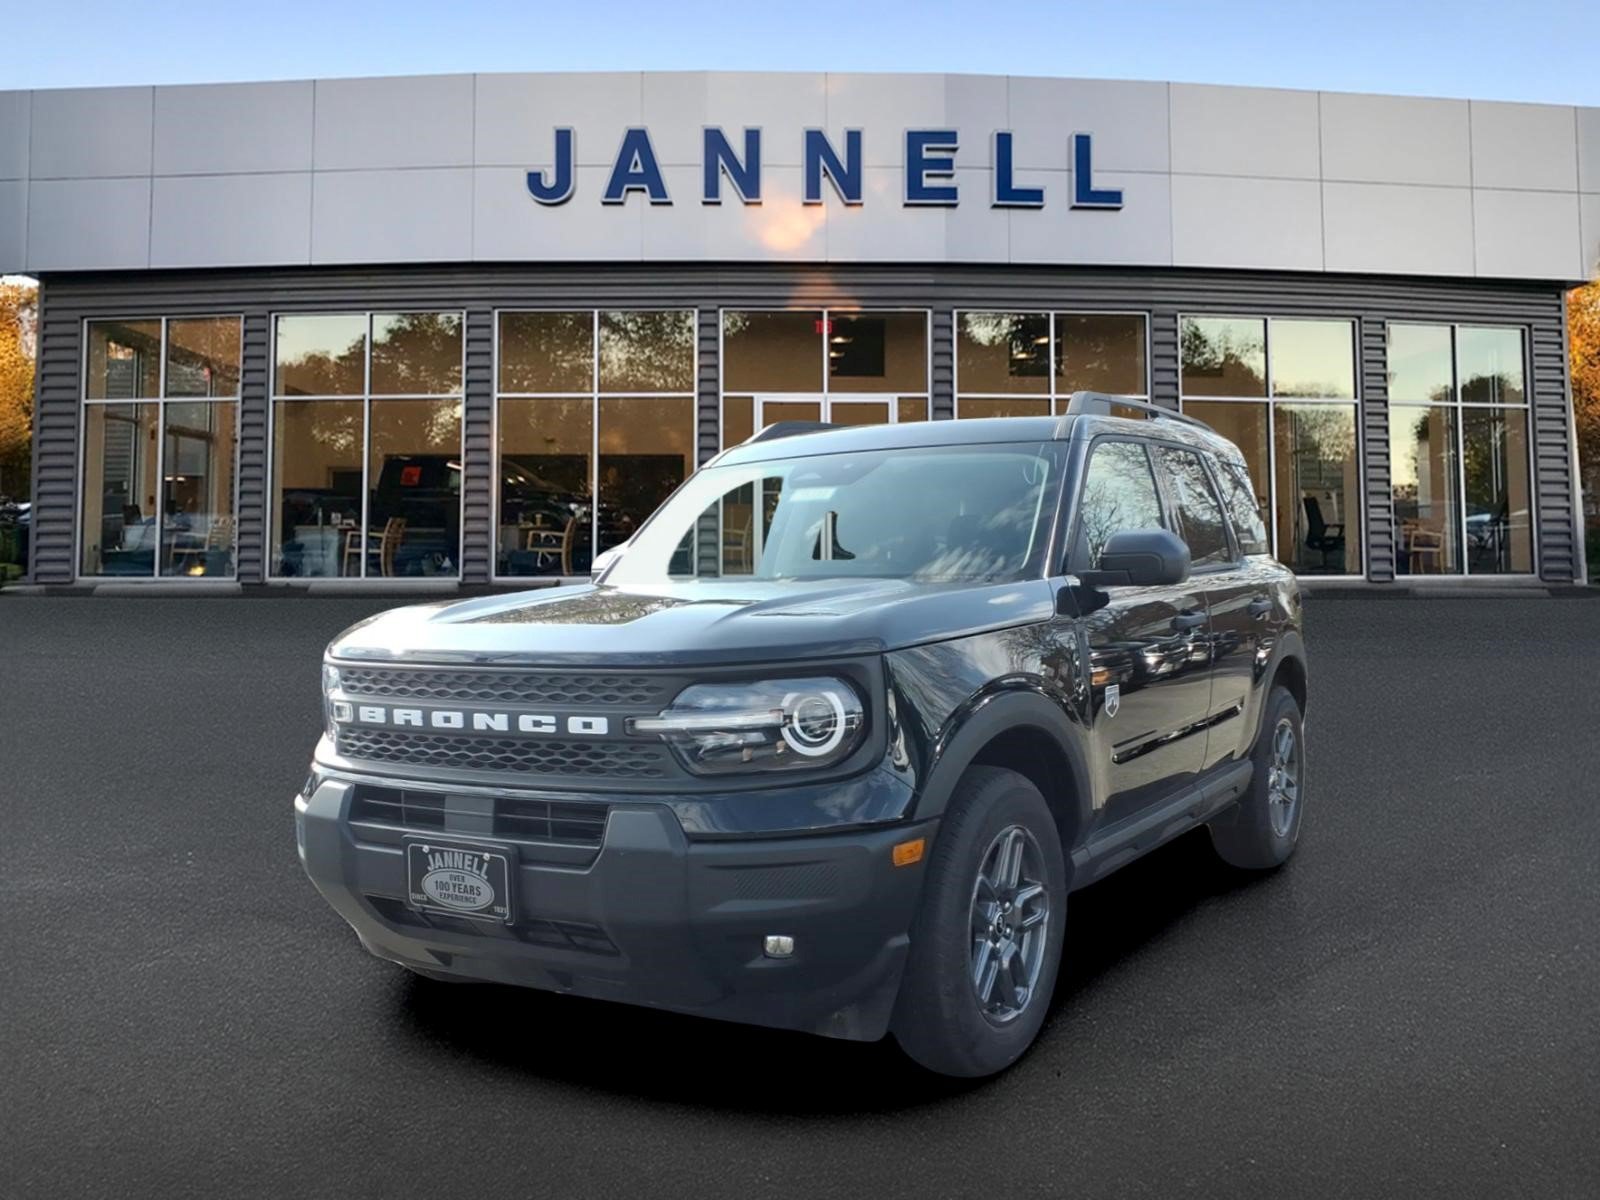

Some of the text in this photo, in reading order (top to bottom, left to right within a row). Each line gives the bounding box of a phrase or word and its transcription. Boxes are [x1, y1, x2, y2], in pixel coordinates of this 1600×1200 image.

[525, 125, 1125, 209] JANNELL
[358, 706, 608, 735] BRONCO
[427, 851, 488, 880] JANNELL
[449, 874, 465, 883] OVER
[434, 880, 481, 896] 100 YEARS
